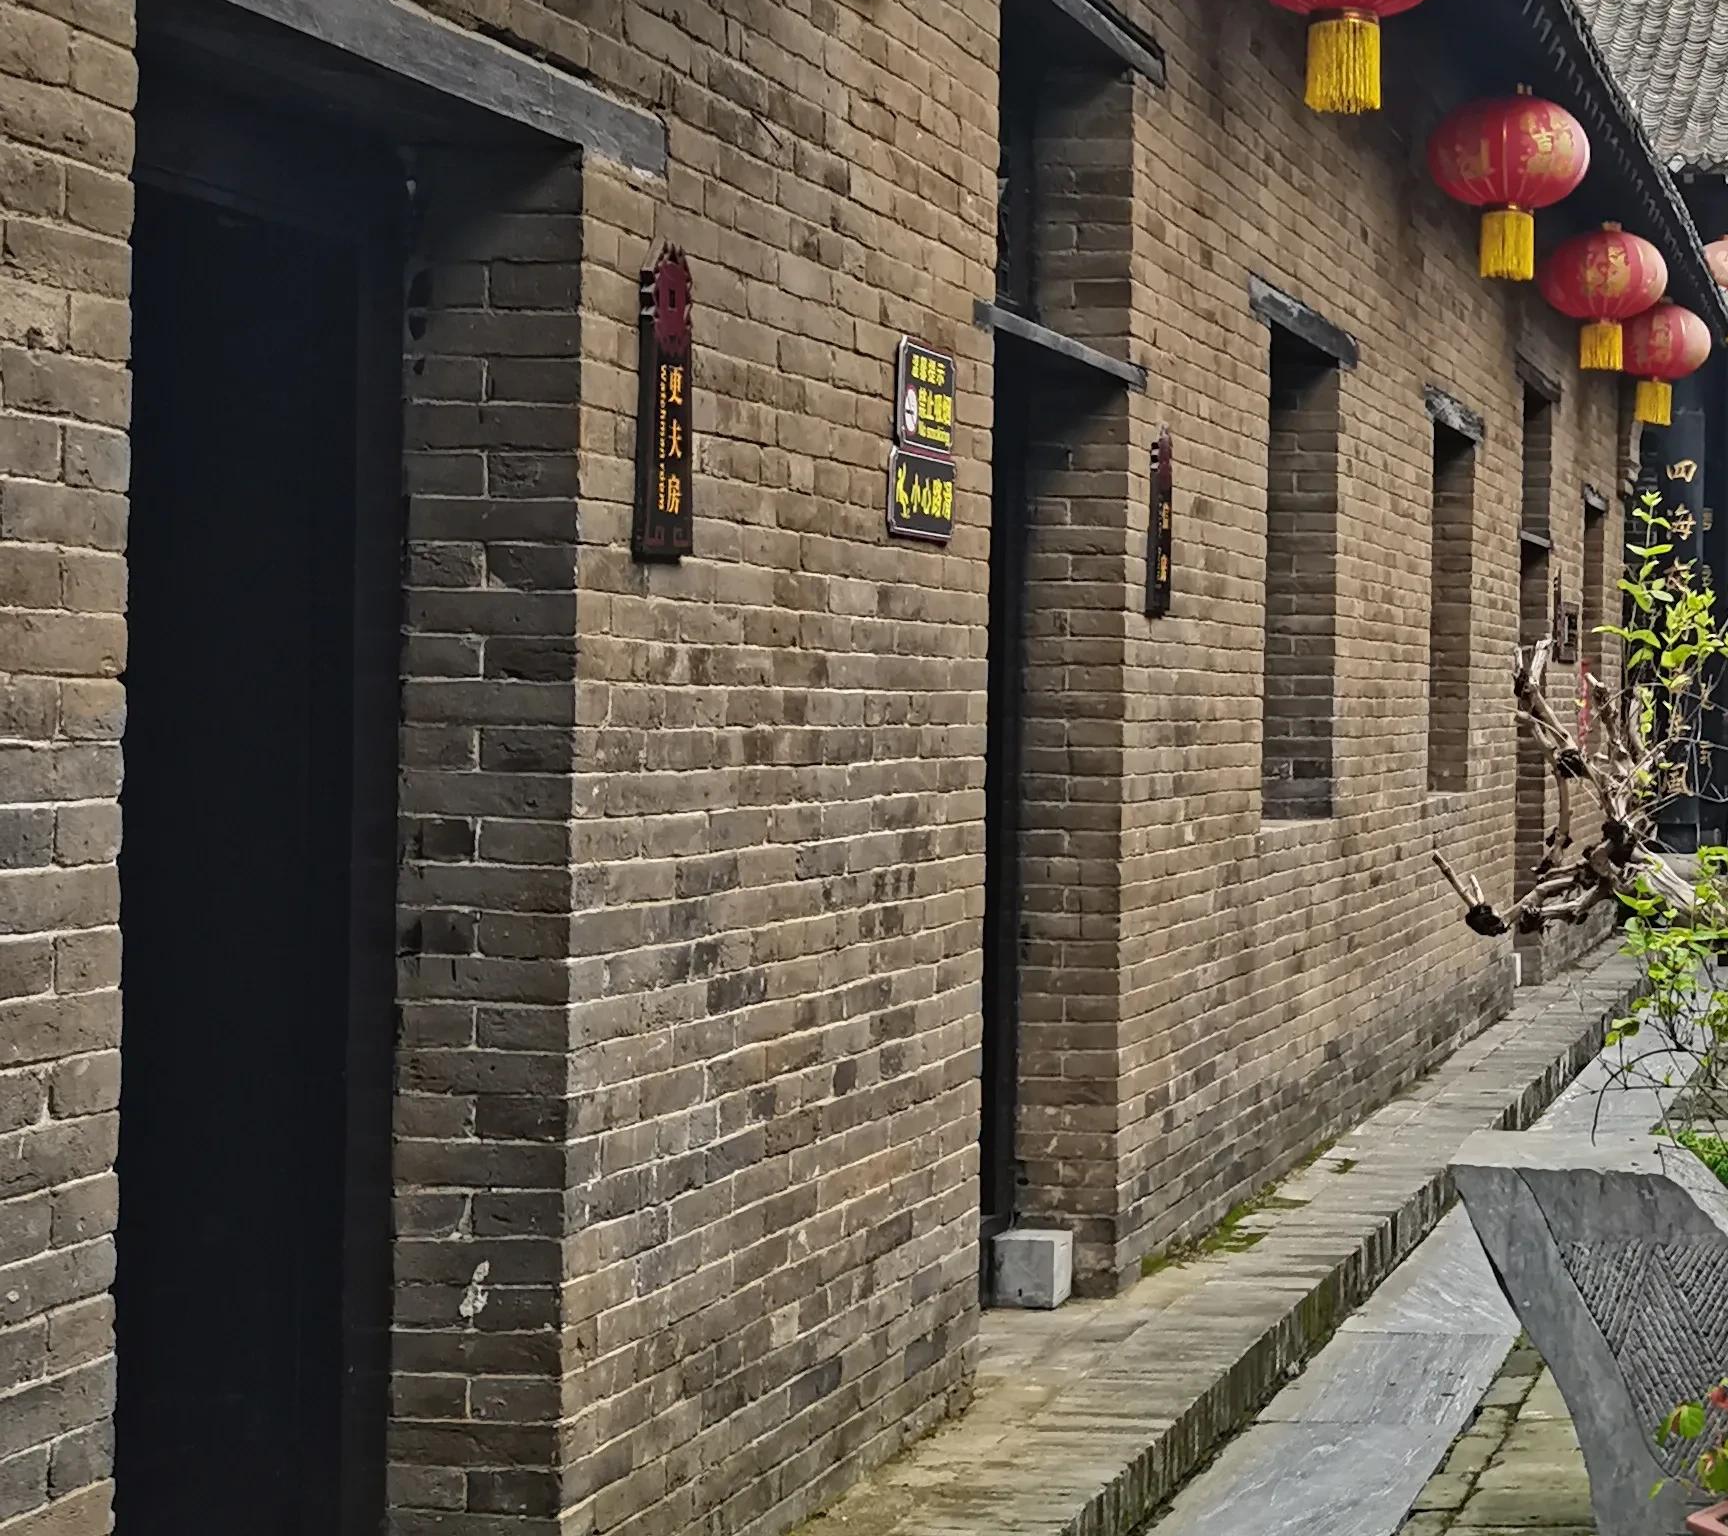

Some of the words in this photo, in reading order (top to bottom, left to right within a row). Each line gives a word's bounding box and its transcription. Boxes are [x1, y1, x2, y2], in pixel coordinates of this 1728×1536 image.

[667, 364, 683, 515] 更夫房
[910, 472, 953, 520] 小心路滑
